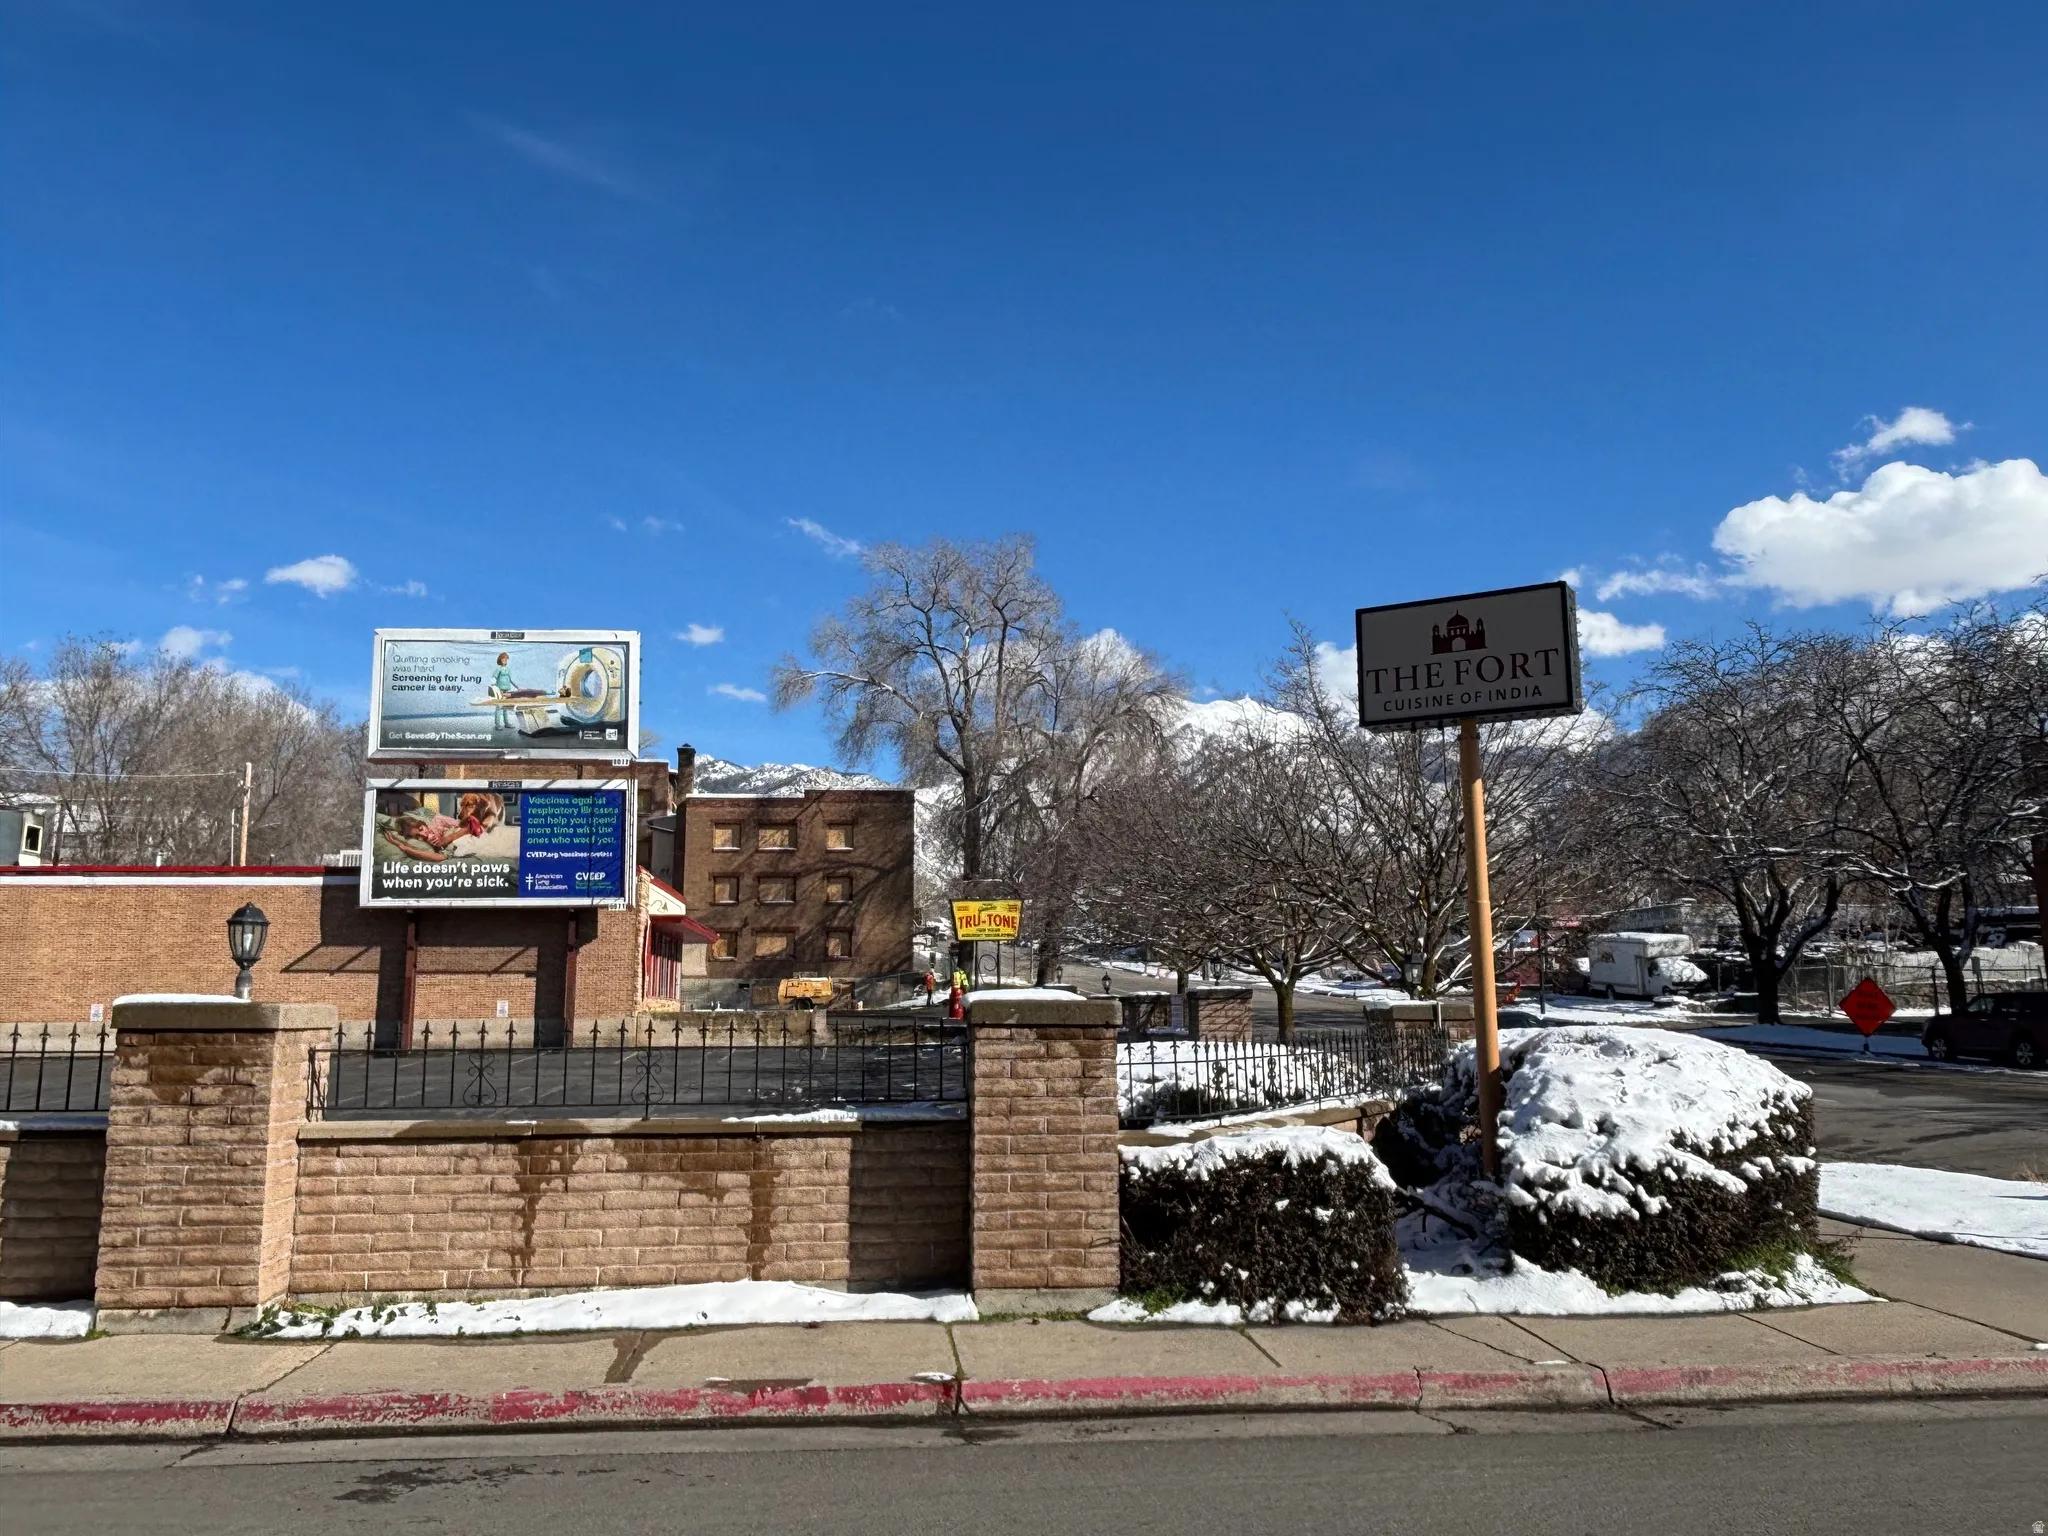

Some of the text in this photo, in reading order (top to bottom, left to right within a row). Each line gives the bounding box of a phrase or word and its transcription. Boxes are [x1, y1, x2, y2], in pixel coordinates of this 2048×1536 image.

[393, 655, 470, 666] Quitting smoking
[1366, 648, 1559, 695] THE FORT
[392, 673, 482, 684] Screening for lung
[392, 684, 425, 692] cancer
[439, 684, 464, 693] easy.
[1383, 685, 1543, 712] CUISINE OF INDIA
[529, 796, 606, 805] Vaccines agaist
[528, 807, 578, 815] respiratory
[548, 816, 567, 825] help
[570, 817, 586, 825] you
[554, 826, 574, 834] time
[551, 836, 570, 844] who
[383, 862, 510, 876] Life doesn't paws
[575, 872, 606, 880] CVEEP
[382, 875, 509, 890] when you're sick.
[958, 913, 1018, 930] TRU-TONE
